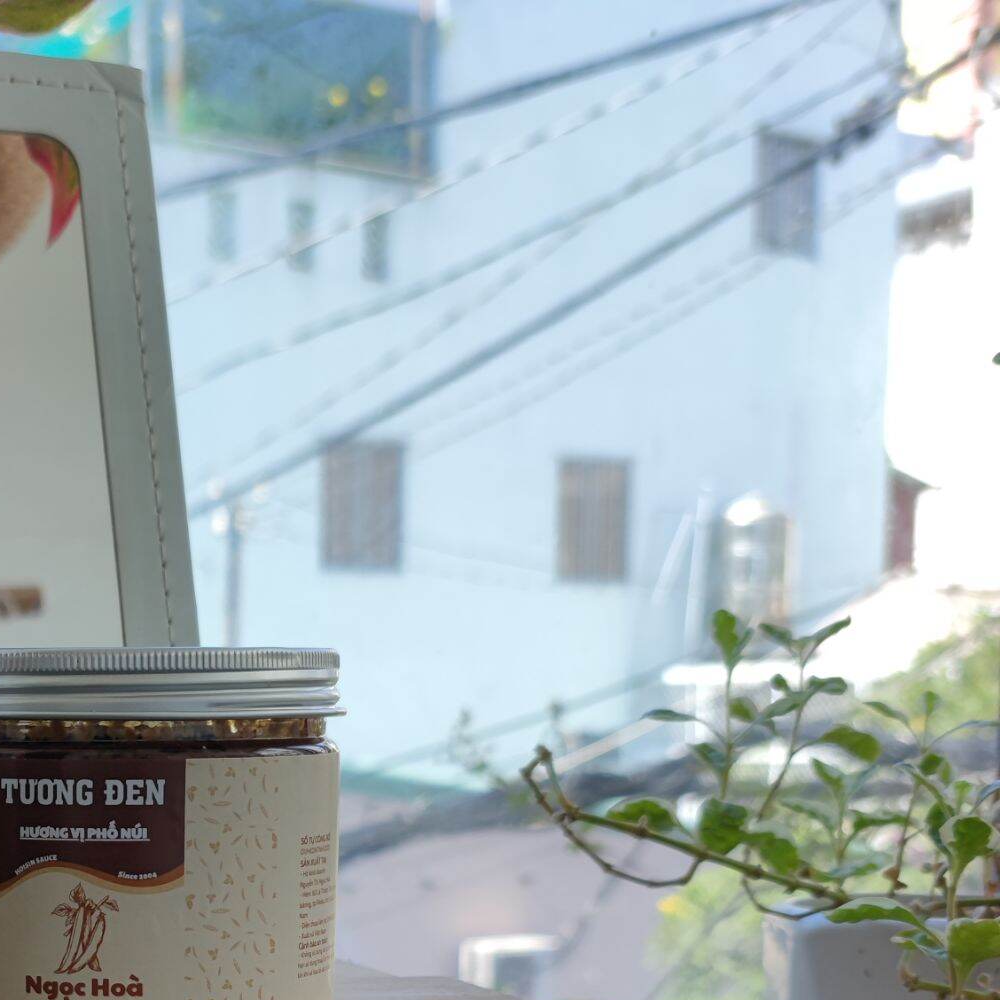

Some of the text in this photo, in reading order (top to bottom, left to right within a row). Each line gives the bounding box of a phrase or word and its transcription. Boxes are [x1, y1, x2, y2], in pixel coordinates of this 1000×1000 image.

[103, 778, 166, 806] ĐEN
[19, 820, 148, 843] HƯƠNG VỊ PHỐ NÚI
[36, 854, 58, 865] SAUCE
[117, 871, 138, 880] Since
[91, 974, 144, 997] Hoà
